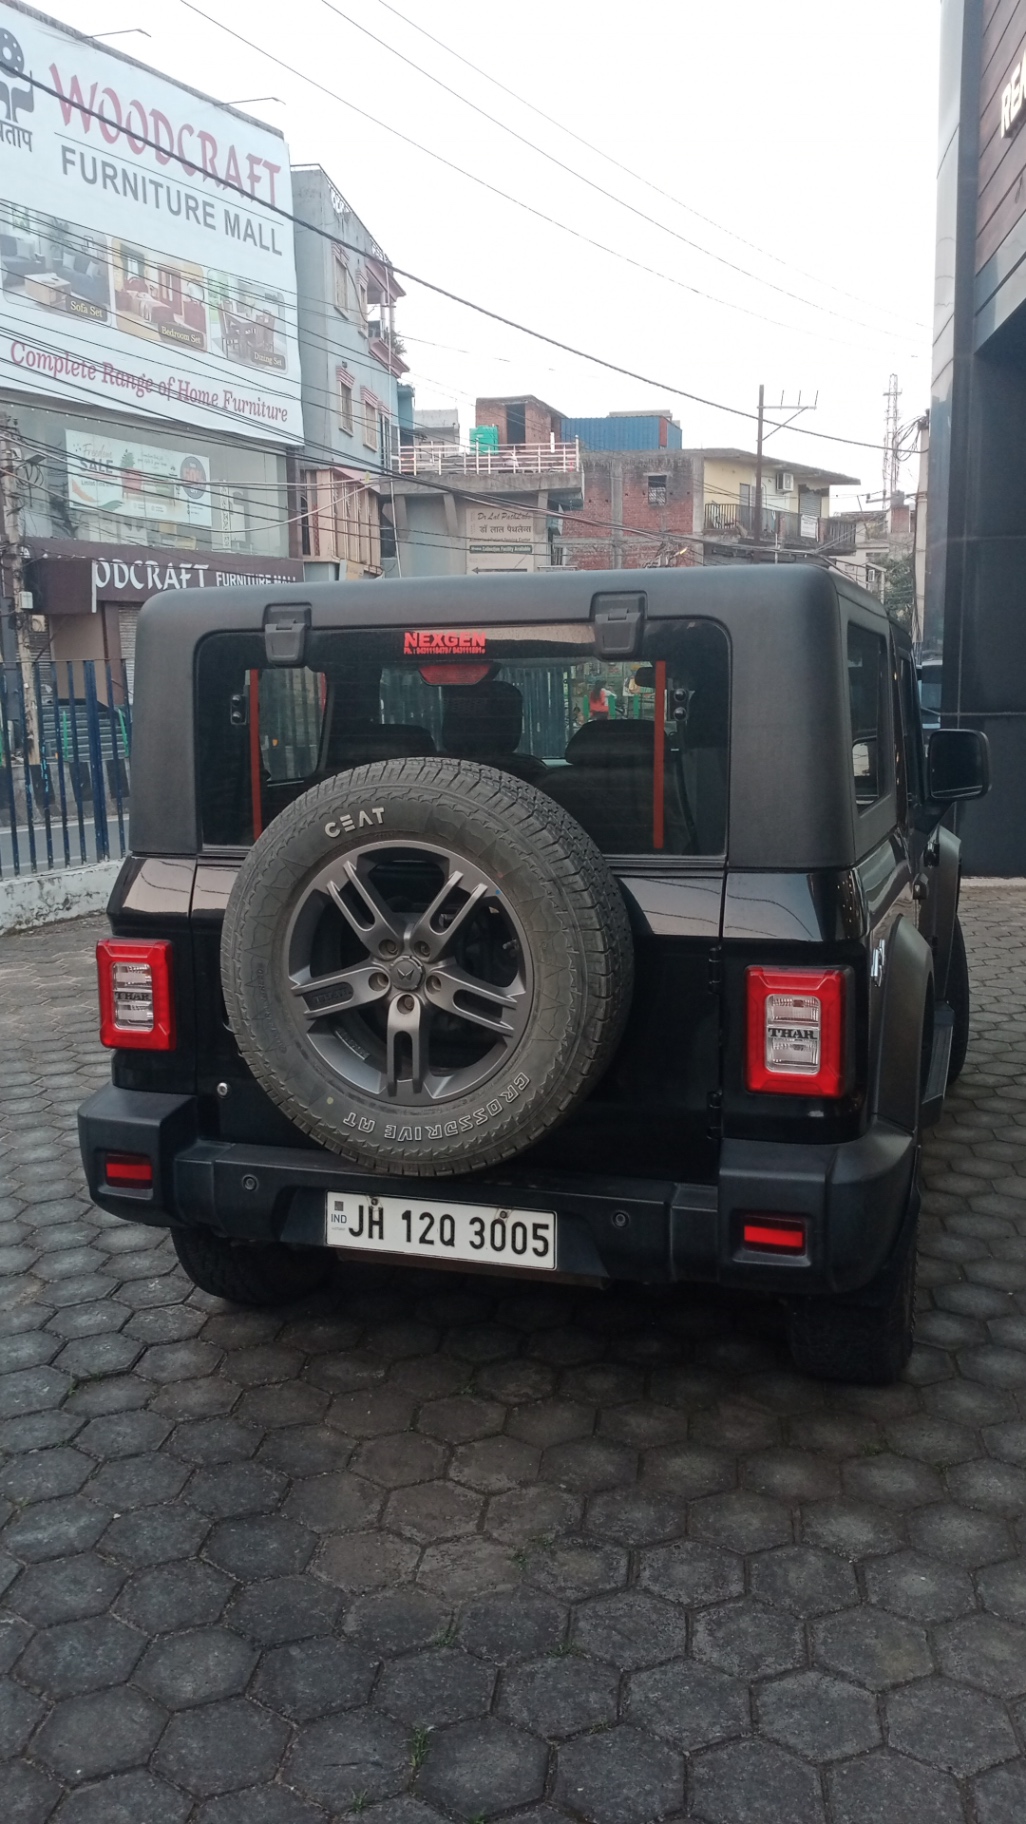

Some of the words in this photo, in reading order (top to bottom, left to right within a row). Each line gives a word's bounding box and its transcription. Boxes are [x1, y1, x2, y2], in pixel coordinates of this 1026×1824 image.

[49, 62, 281, 207] WOODCRAFT
[61, 145, 216, 231] FURNITURE
[224, 208, 283, 256] MALL
[70, 300, 88, 314] Sofa
[90, 306, 103, 318] Set
[161, 325, 190, 341] Bedroom
[191, 334, 201, 344] Set
[254, 351, 272, 365] Dining
[273, 357, 282, 366] Set
[10, 340, 96, 382] Complete
[101, 361, 153, 398] Range
[159, 376, 175, 402] of
[178, 379, 219, 408] Home
[222, 389, 288, 422] Furniture
[80, 457, 113, 474] SALE
[404, 631, 486, 648] NEXGEN
[324, 807, 385, 838] CEAT
[114, 991, 152, 1001] THAR
[768, 1027, 818, 1040] THAR
[384, 1072, 531, 1142] CROSSDRIVE
[343, 1112, 376, 1133] AT
[331, 1213, 347, 1225] IND
[348, 1204, 384, 1240] JH
[401, 1209, 456, 1248] 12Q
[469, 1216, 550, 1257] 3005
